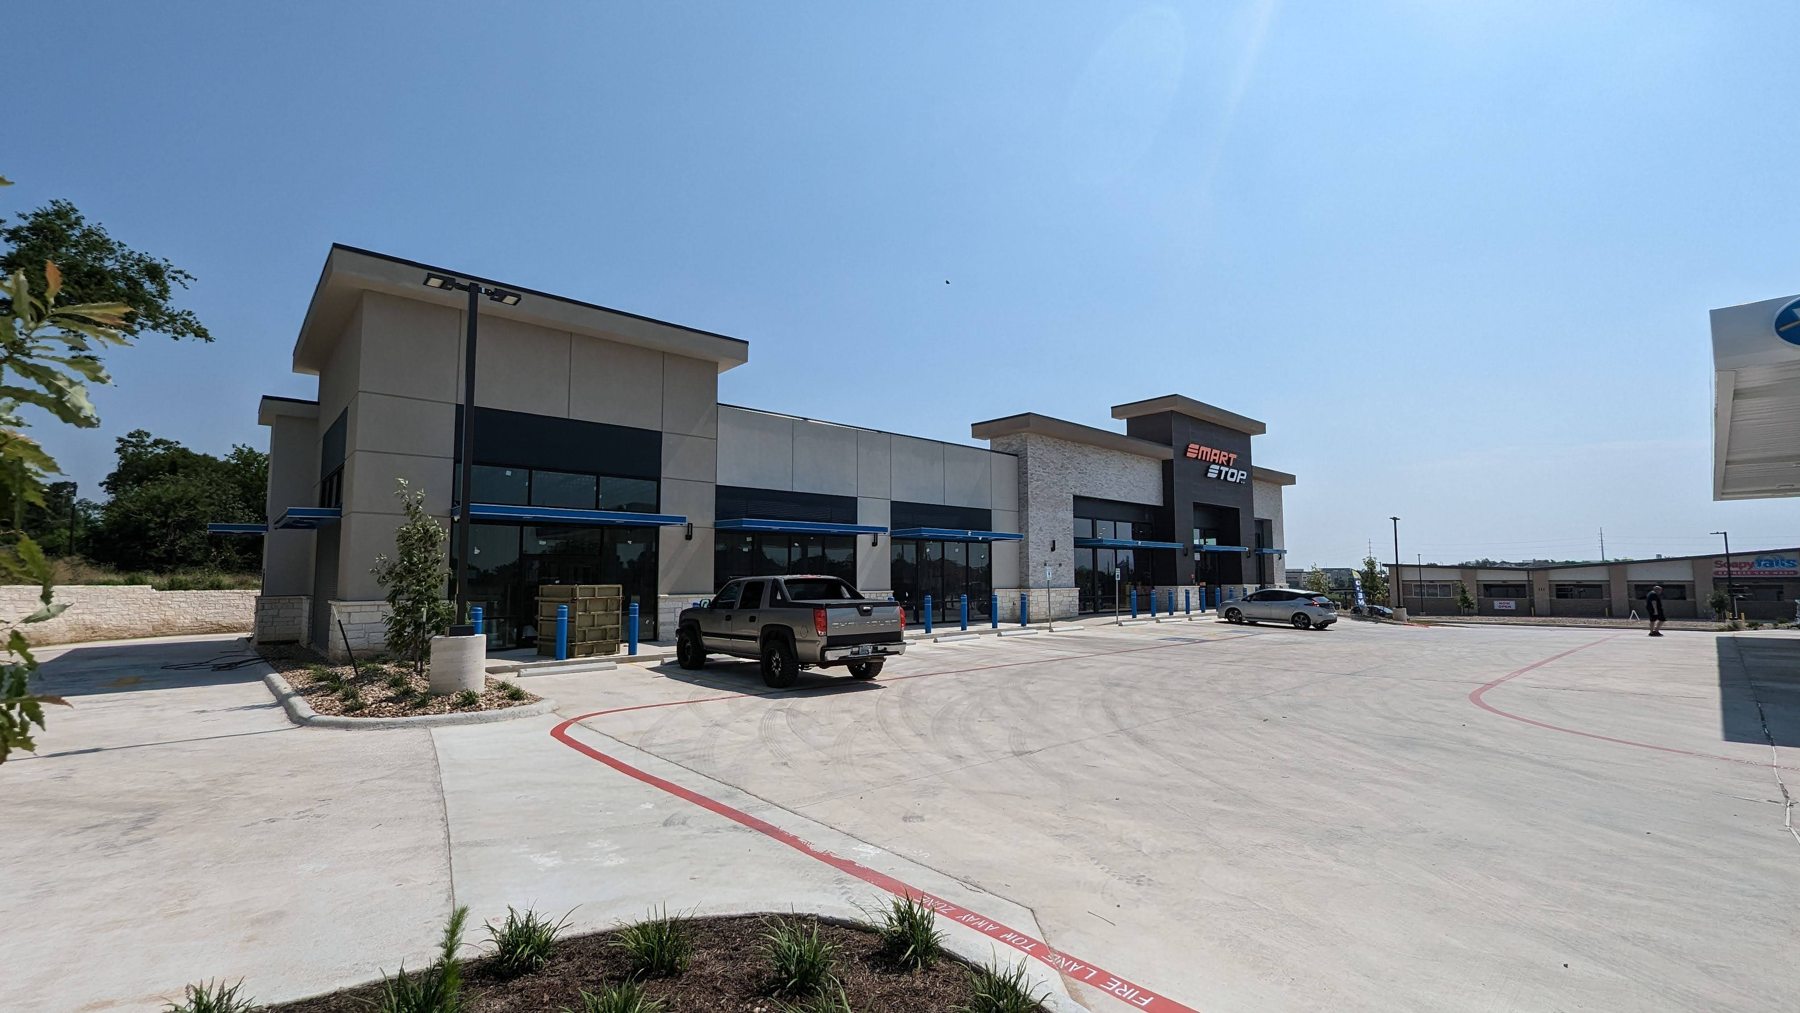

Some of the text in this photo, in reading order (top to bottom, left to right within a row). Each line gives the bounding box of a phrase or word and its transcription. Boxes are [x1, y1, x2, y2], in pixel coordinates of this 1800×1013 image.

[1186, 443, 1237, 466] SMART
[1207, 464, 1247, 483] STOP
[955, 915, 1000, 932] AWAY
[999, 932, 1037, 951] TOW
[1041, 953, 1097, 979] LANE
[1100, 977, 1154, 1007] FIRE
